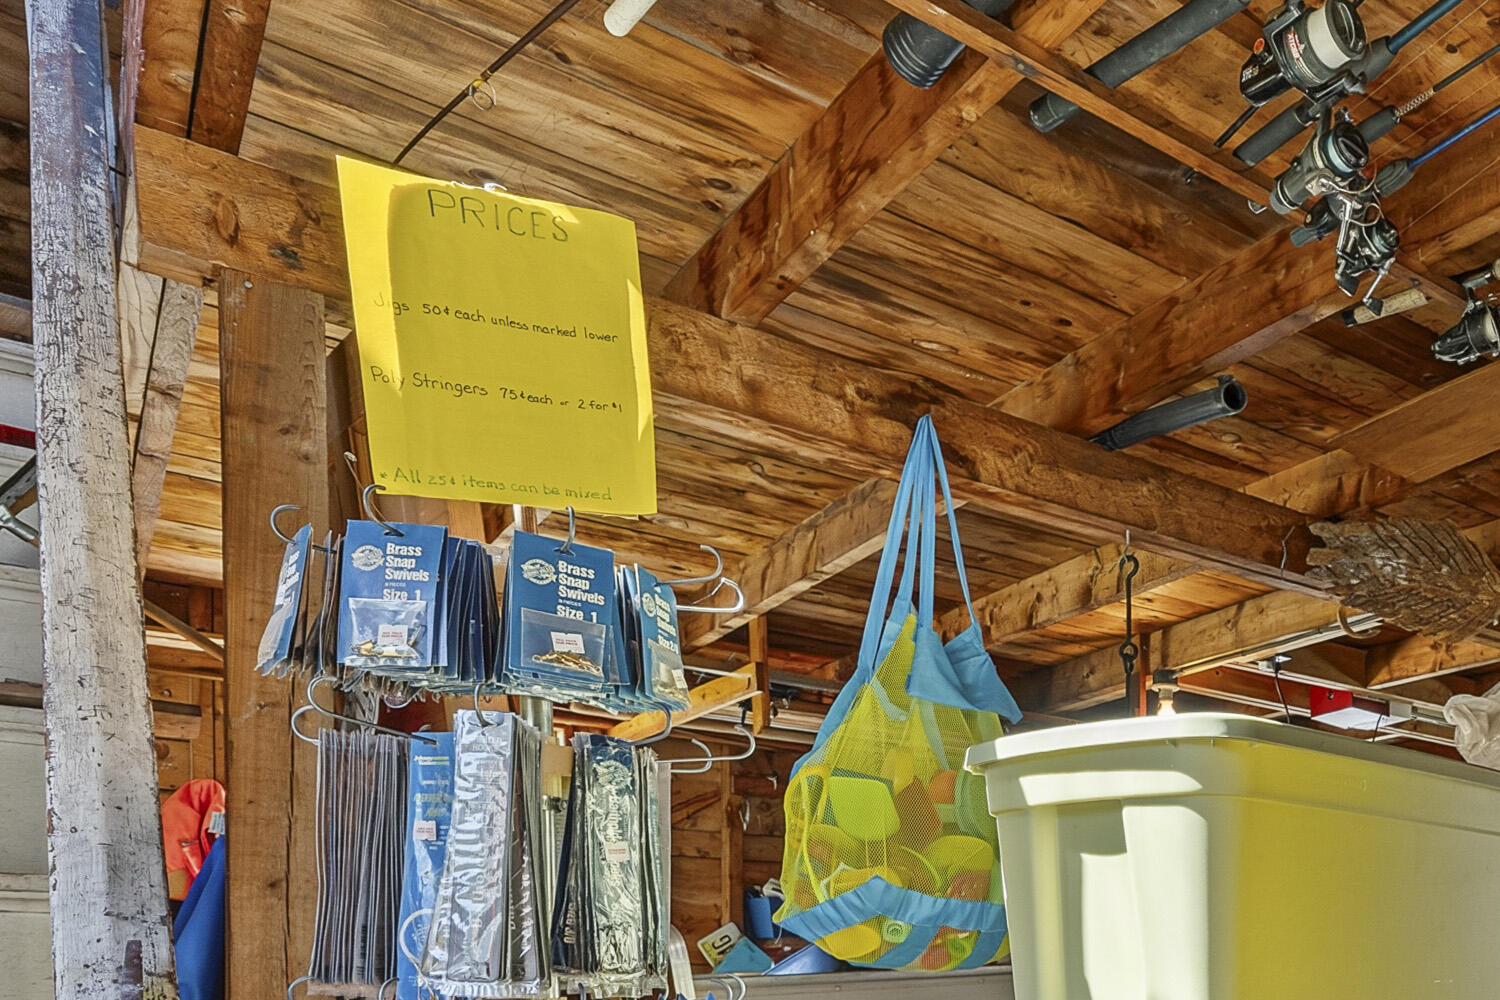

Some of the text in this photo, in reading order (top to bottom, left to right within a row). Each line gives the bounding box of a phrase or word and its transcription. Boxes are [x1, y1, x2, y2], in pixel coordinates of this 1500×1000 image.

[427, 188, 569, 242] PRICES
[454, 308, 486, 323] each
[490, 314, 529, 331] unless
[532, 322, 577, 338] marked
[583, 326, 619, 343] lower
[369, 365, 405, 391] Poly
[412, 372, 489, 398] Stringers
[393, 466, 422, 484] All
[462, 473, 506, 492] items
[511, 480, 539, 494] can
[543, 483, 561, 496] be
[565, 486, 613, 502] mixed
[386, 542, 422, 557] Brass
[385, 556, 416, 570] Snap
[558, 560, 596, 579] Brass
[384, 568, 430, 582] Swivels
[558, 573, 590, 591] Snap
[383, 588, 409, 601] Size
[558, 585, 605, 606] Swivels
[556, 605, 584, 621] Size
